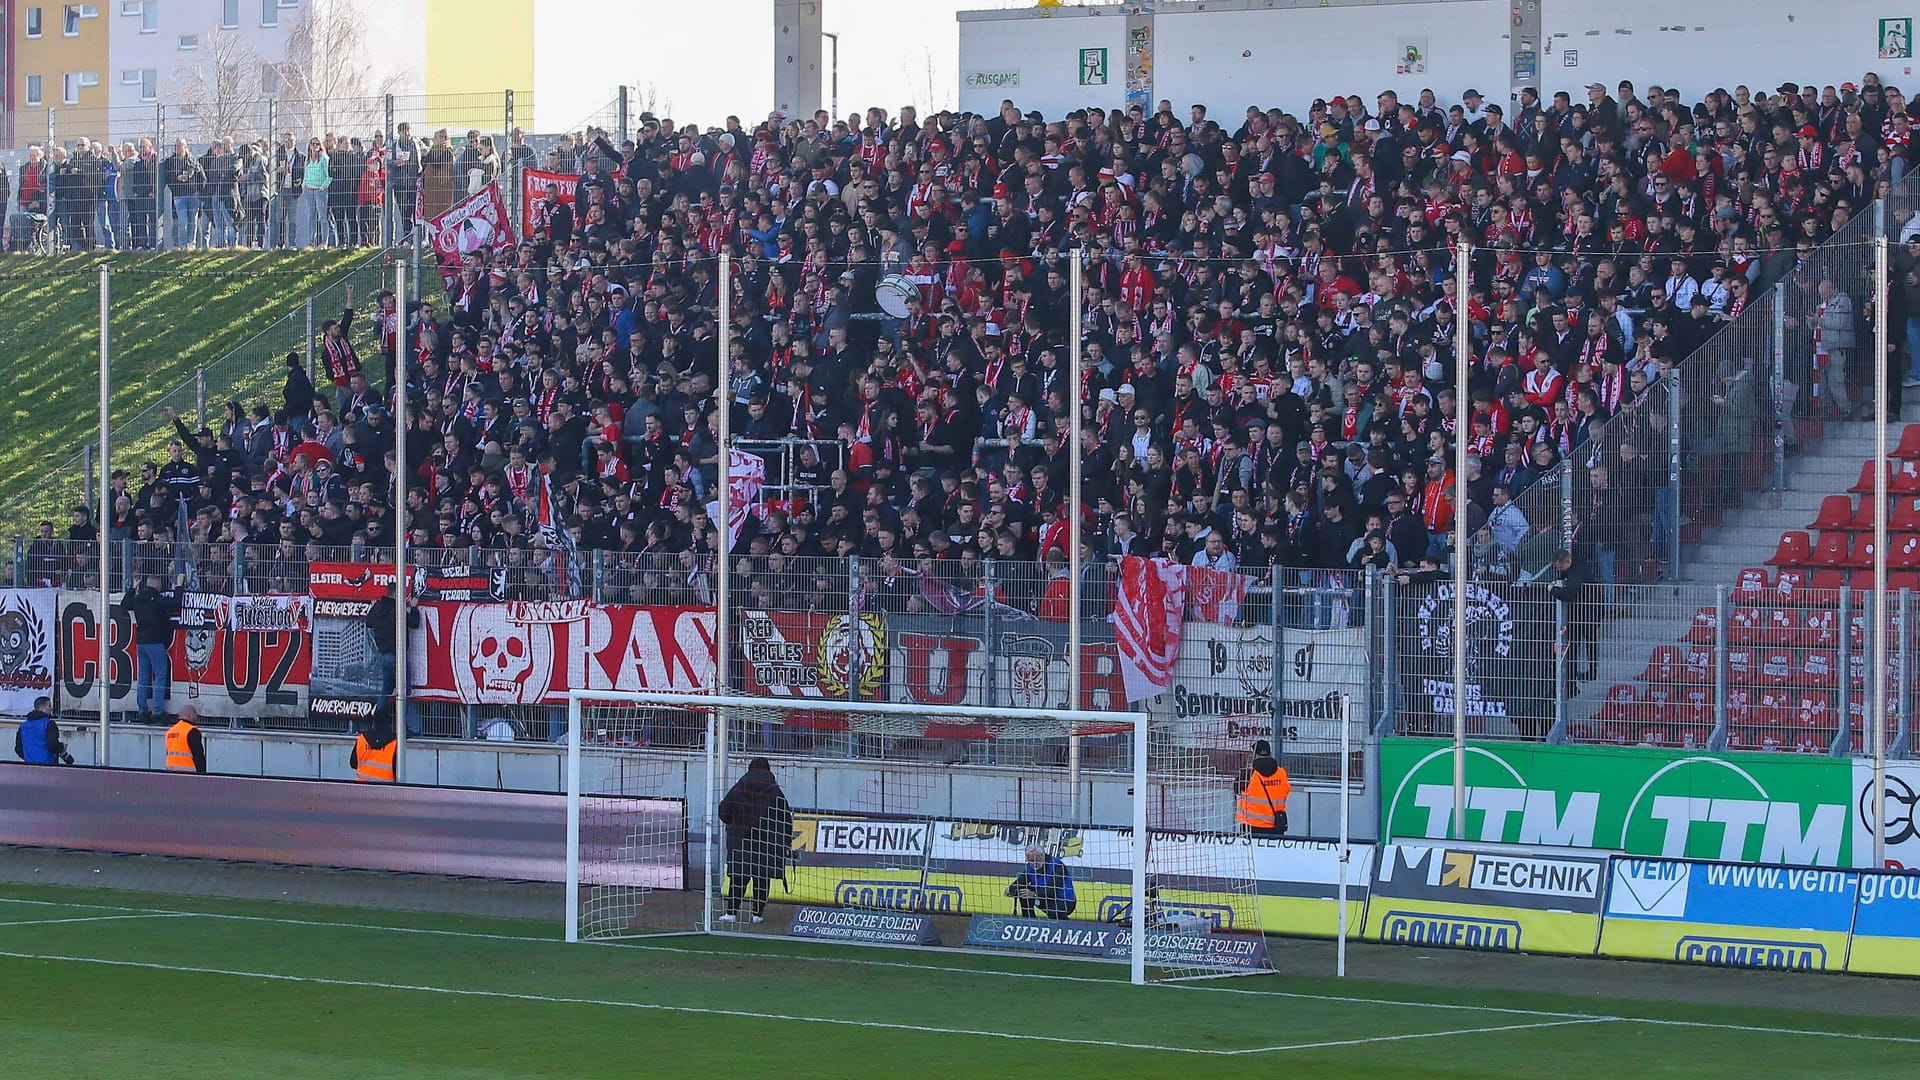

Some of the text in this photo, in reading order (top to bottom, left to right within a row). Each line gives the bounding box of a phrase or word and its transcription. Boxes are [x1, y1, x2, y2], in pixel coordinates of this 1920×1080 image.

[976, 73, 1018, 86] AUSGANG
[311, 573, 411, 587] ELSTER FROT
[442, 565, 470, 577] BERLIN
[440, 590, 471, 601] TERROR
[179, 608, 205, 626] JUNGS
[745, 619, 774, 639] RED
[750, 643, 804, 662] EAGLES
[1207, 639, 1228, 677] 19
[1294, 641, 1316, 682] 97
[755, 666, 819, 687] COTTBUS
[1413, 783, 1600, 848] TTM
[820, 824, 924, 852] TECHNIK
[1650, 795, 1848, 868] TTM
[1478, 860, 1595, 894] TECHNIK
[1629, 860, 1678, 882] VEM
[842, 886, 951, 912] COMEDIA
[798, 908, 923, 932] ÖKOLOGISCHE FOLIEN
[813, 927, 852, 938] CHEMISCHE
[852, 930, 876, 939] WERKE
[876, 931, 907, 941] SACHSEN
[907, 934, 917, 942] AG
[1002, 923, 1109, 948] SUPRAMAX
[1115, 930, 1258, 955] ÖKLOGISCHE FOLIEN
[1389, 918, 1509, 950] COMEDIA
[1109, 947, 1127, 956] CWS
[1177, 953, 1204, 962] WERKE
[1204, 955, 1239, 965] SACHSEN
[1684, 943, 1814, 971] COMEDIA
